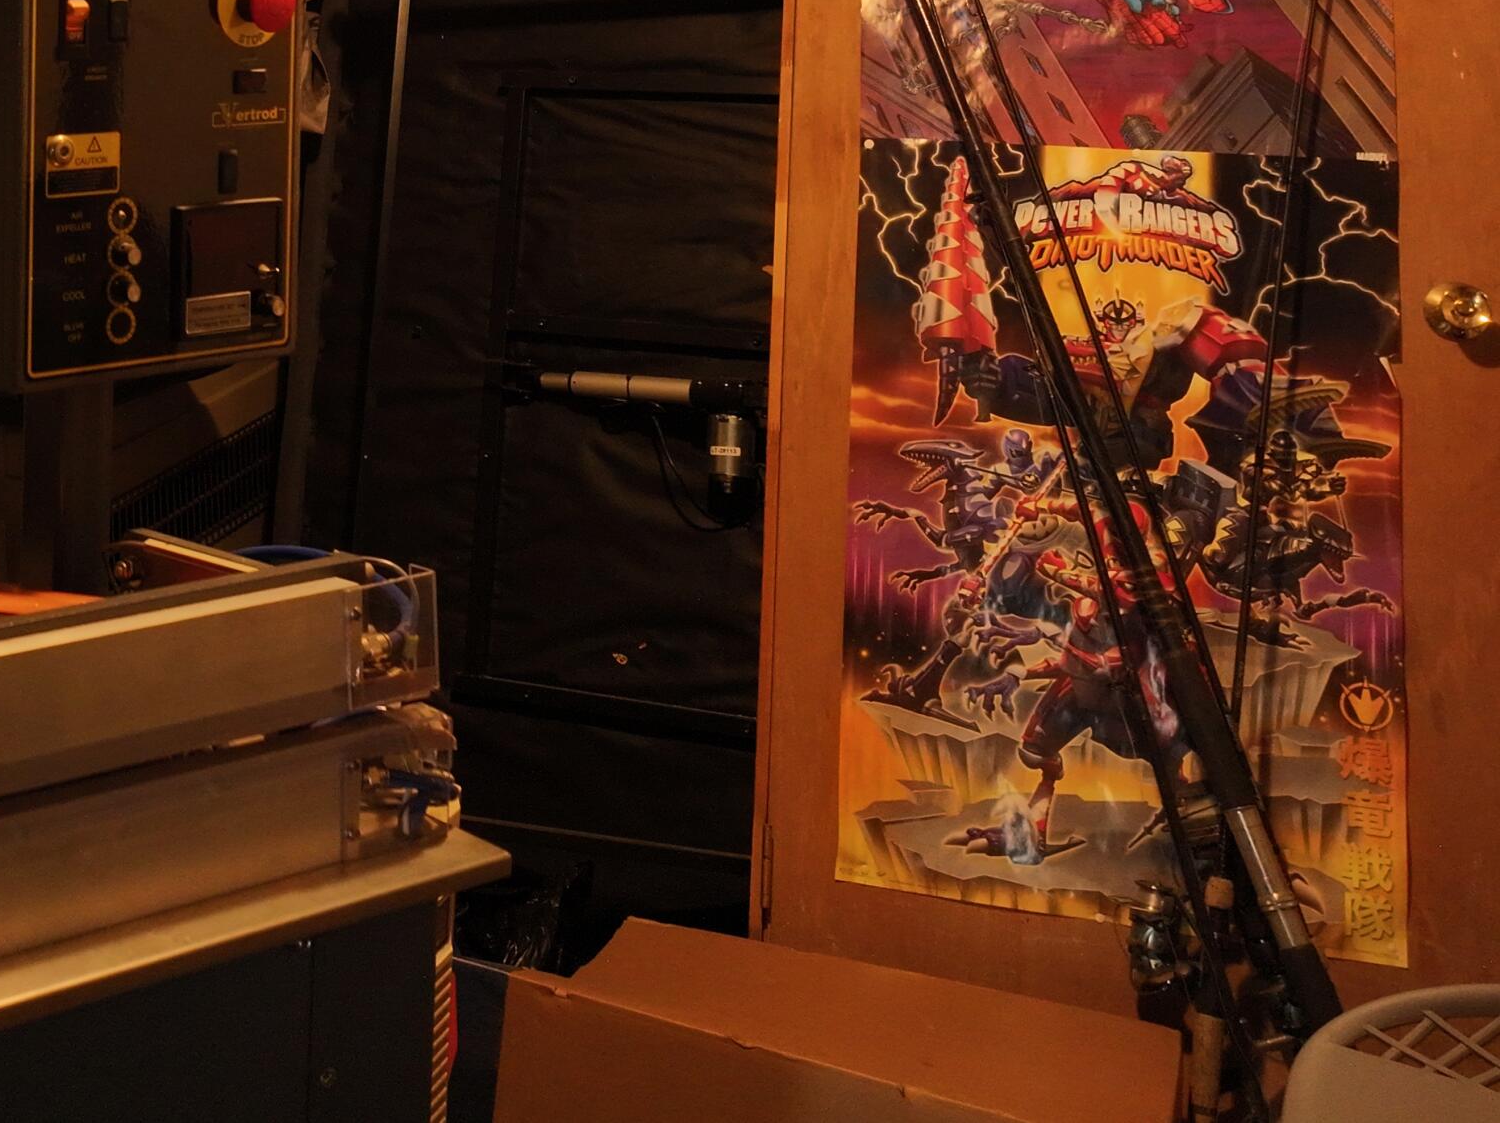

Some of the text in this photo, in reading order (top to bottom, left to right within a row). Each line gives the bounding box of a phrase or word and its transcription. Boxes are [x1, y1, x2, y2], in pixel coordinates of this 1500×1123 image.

[238, 32, 265, 45] STOP
[74, 156, 108, 166] CAUTION
[1118, 193, 1244, 257] RANGERS
